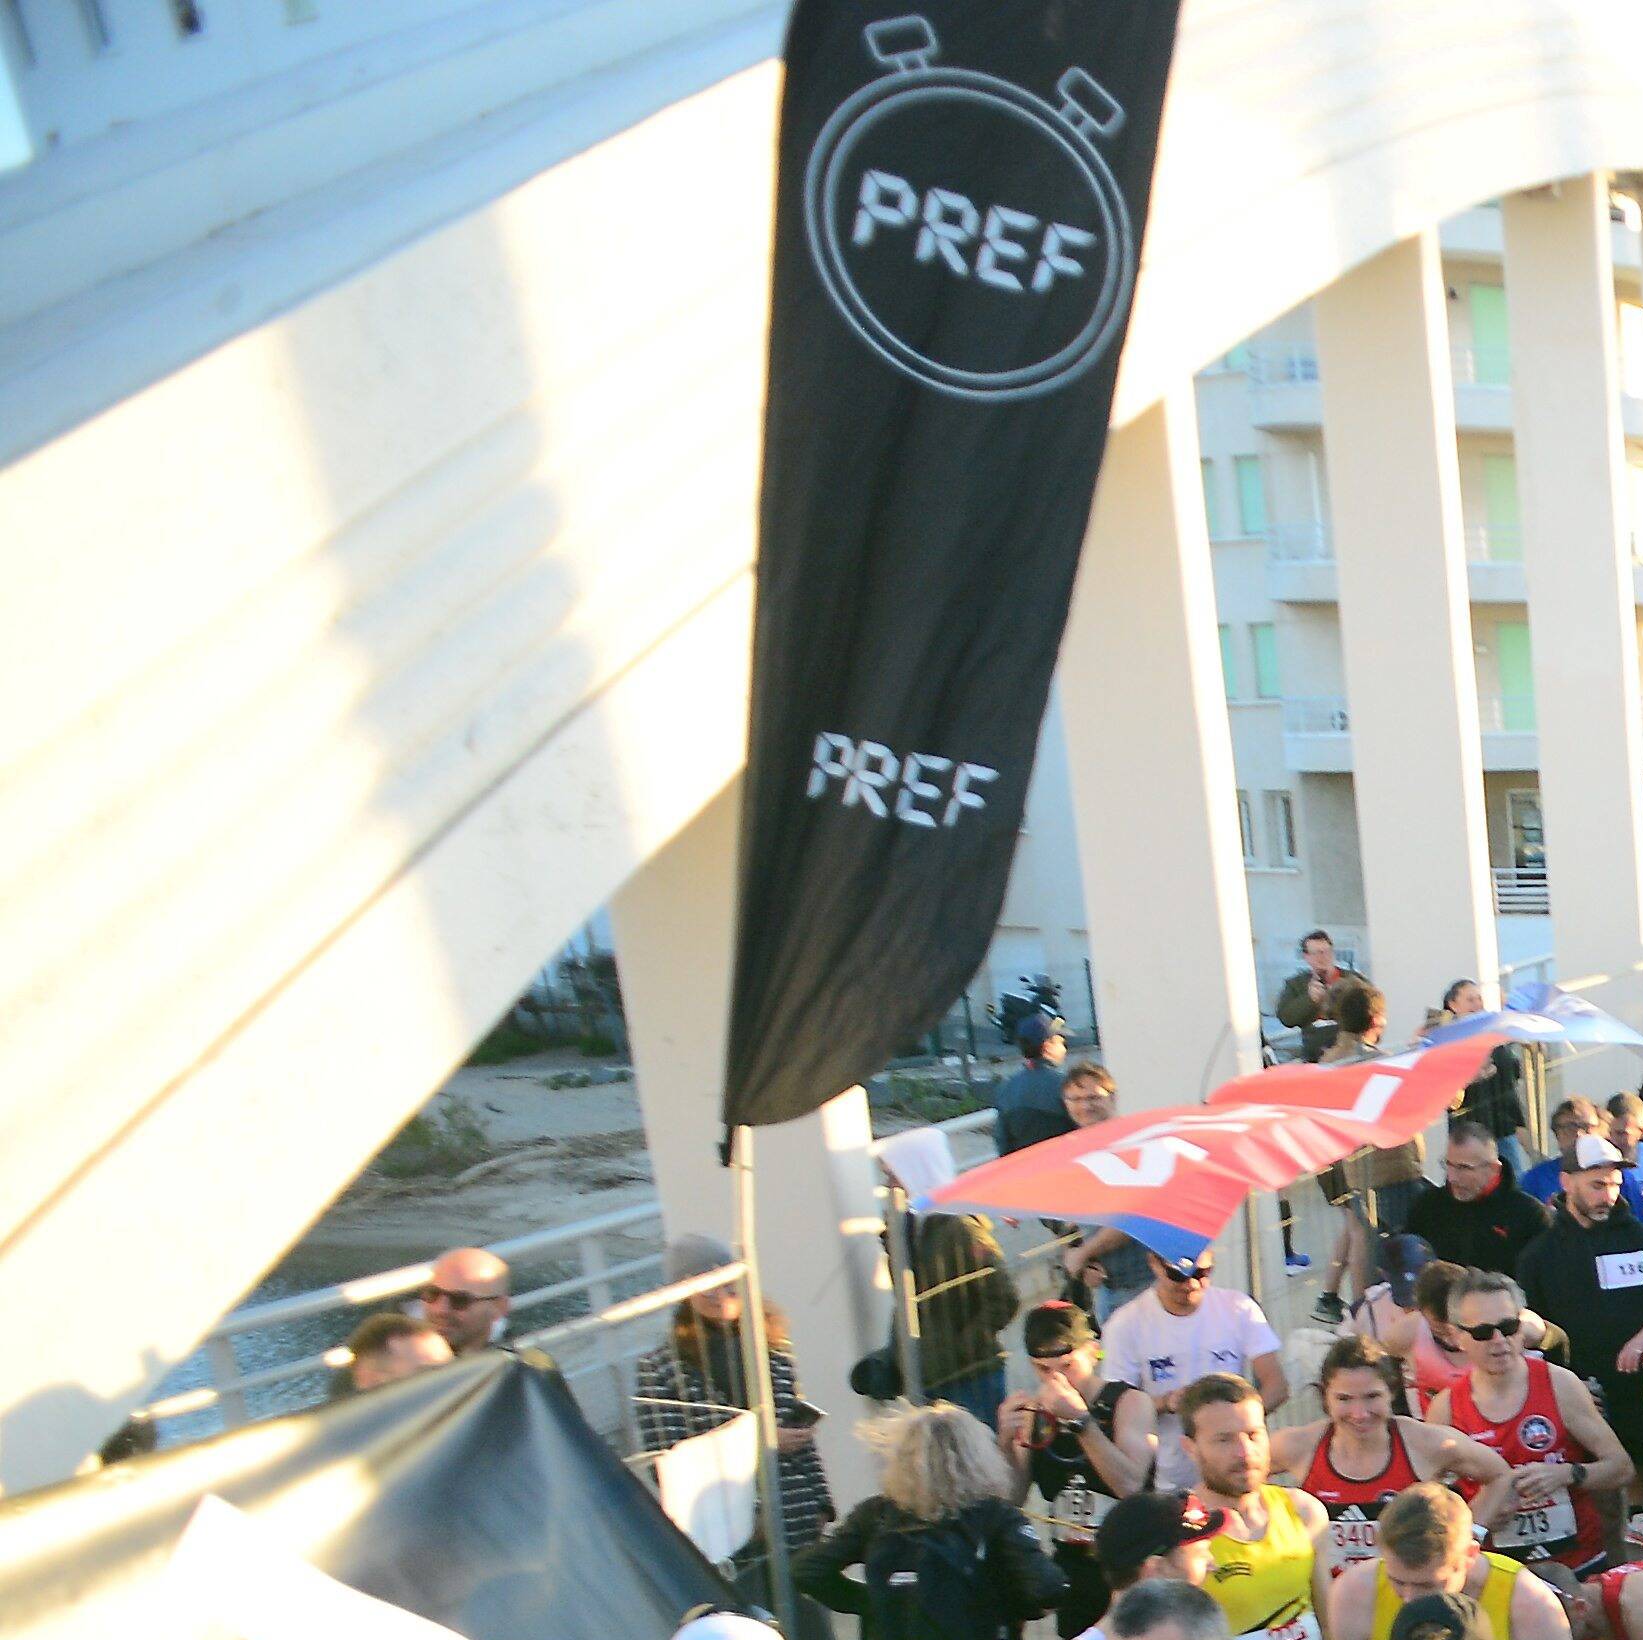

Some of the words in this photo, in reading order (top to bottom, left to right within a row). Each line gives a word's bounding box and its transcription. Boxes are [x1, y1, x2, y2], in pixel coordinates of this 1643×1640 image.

[852, 168, 1097, 293] PREF
[807, 731, 999, 828] PREF
[1334, 1522, 1377, 1548] 340
[1514, 1509, 1550, 1537] 213
